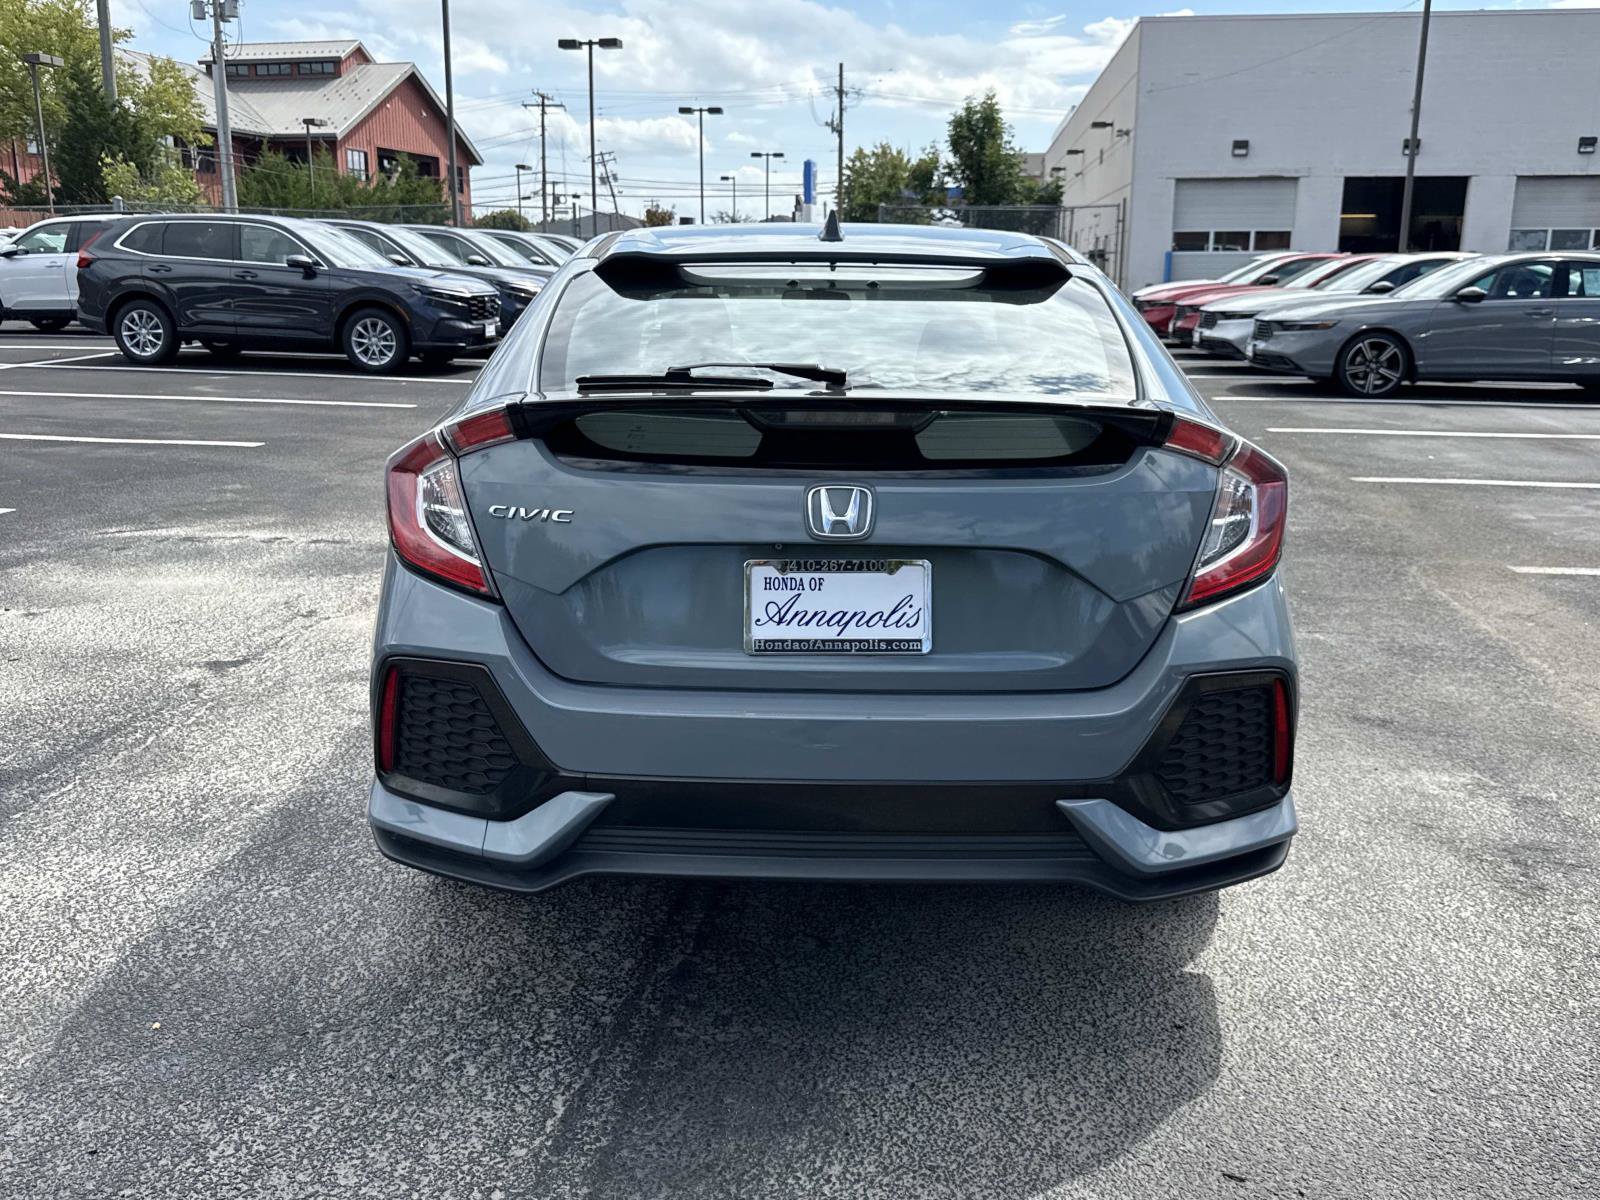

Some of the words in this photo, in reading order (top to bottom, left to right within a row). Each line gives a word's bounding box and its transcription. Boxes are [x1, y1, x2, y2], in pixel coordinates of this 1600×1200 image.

[488, 504, 575, 524] CIVIC
[788, 560, 887, 572] 410-267-7100
[763, 577, 805, 591] HONDA
[808, 577, 825, 591] OF
[754, 593, 922, 637] Annapolis
[754, 639, 922, 653] HondaofAnnapolis.com
